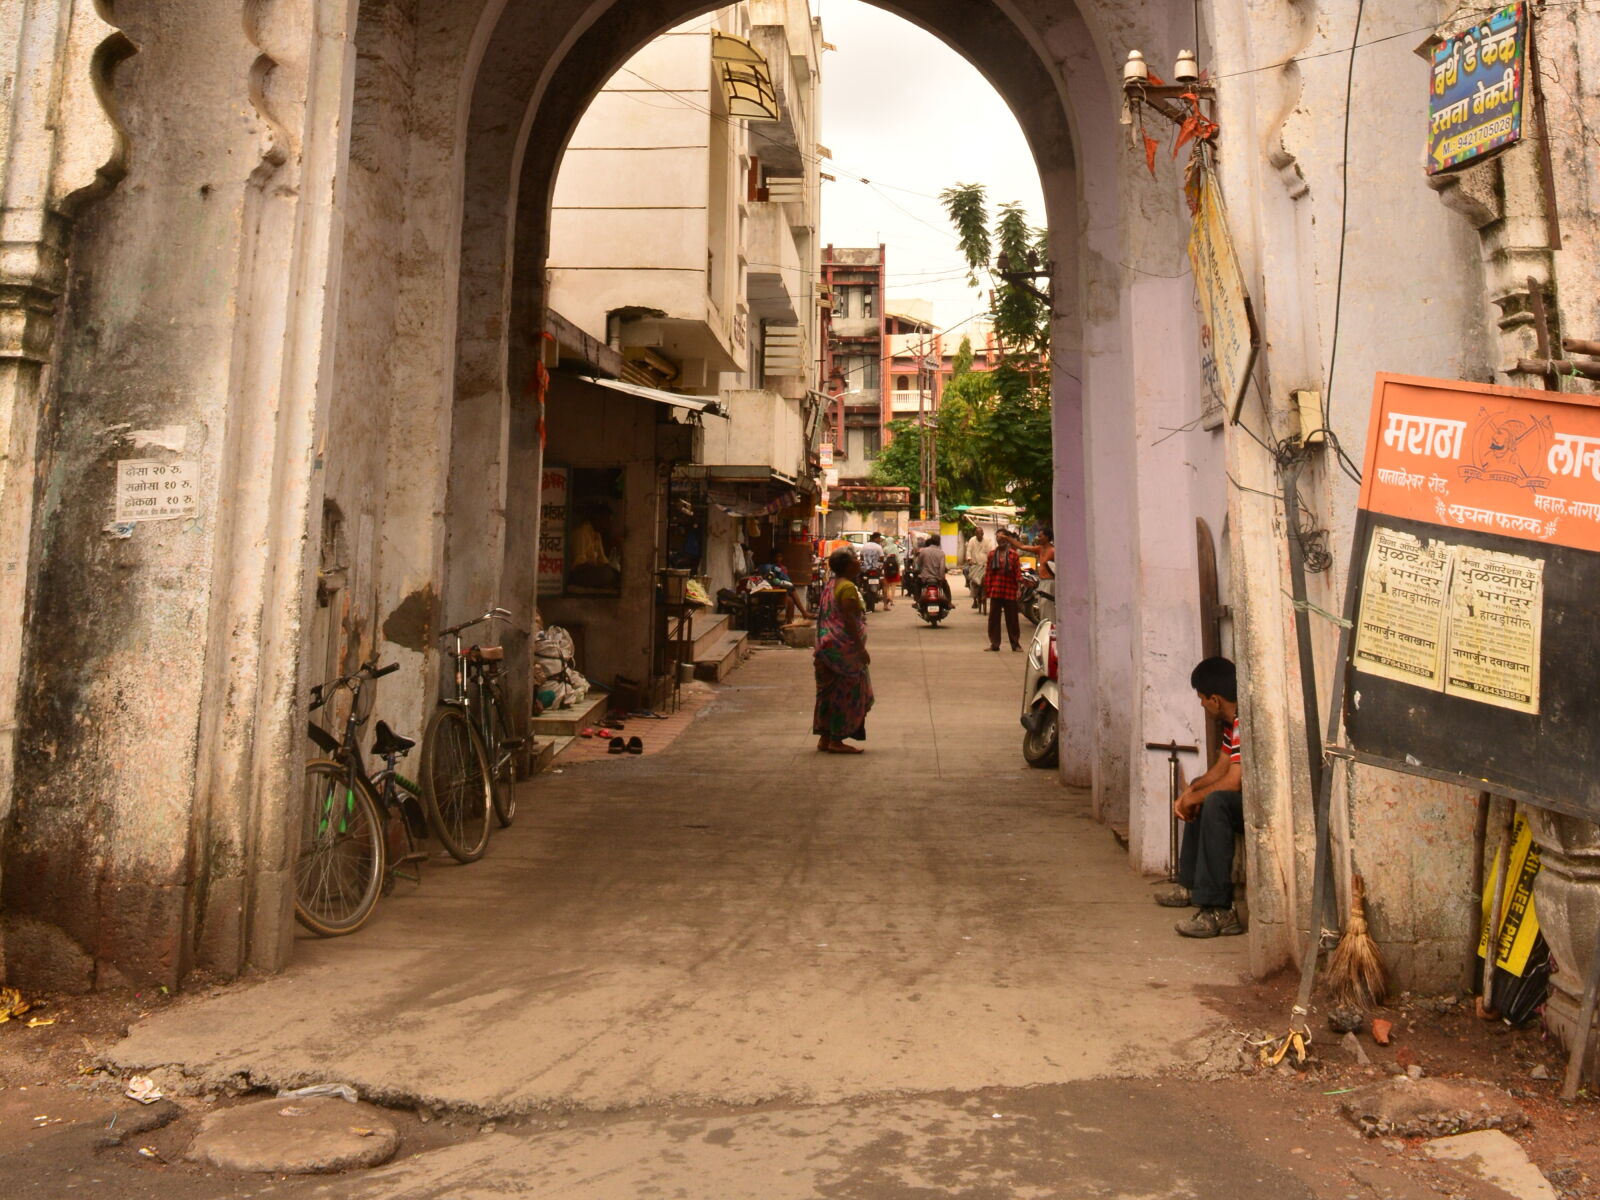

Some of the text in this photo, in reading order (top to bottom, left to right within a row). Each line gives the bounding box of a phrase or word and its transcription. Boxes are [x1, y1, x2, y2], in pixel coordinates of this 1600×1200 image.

[1481, 26, 1518, 65] केक
[1473, 67, 1516, 116] बेकरी
[1383, 411, 1600, 484] मराठा लान्
[153, 466, 166, 475] २०
[125, 480, 159, 491] समोसा
[164, 481, 177, 490] १०
[167, 495, 179, 505] १०
[1448, 504, 1543, 534] सुचना फलक
[1390, 567, 1442, 587] भगंदर
[1476, 589, 1533, 609] भगंदर
[1398, 631, 1436, 650] दवाखाना
[1489, 656, 1530, 673] दवाखाना
[1511, 882, 1530, 914] JEE
[1498, 923, 1518, 964] PMT
